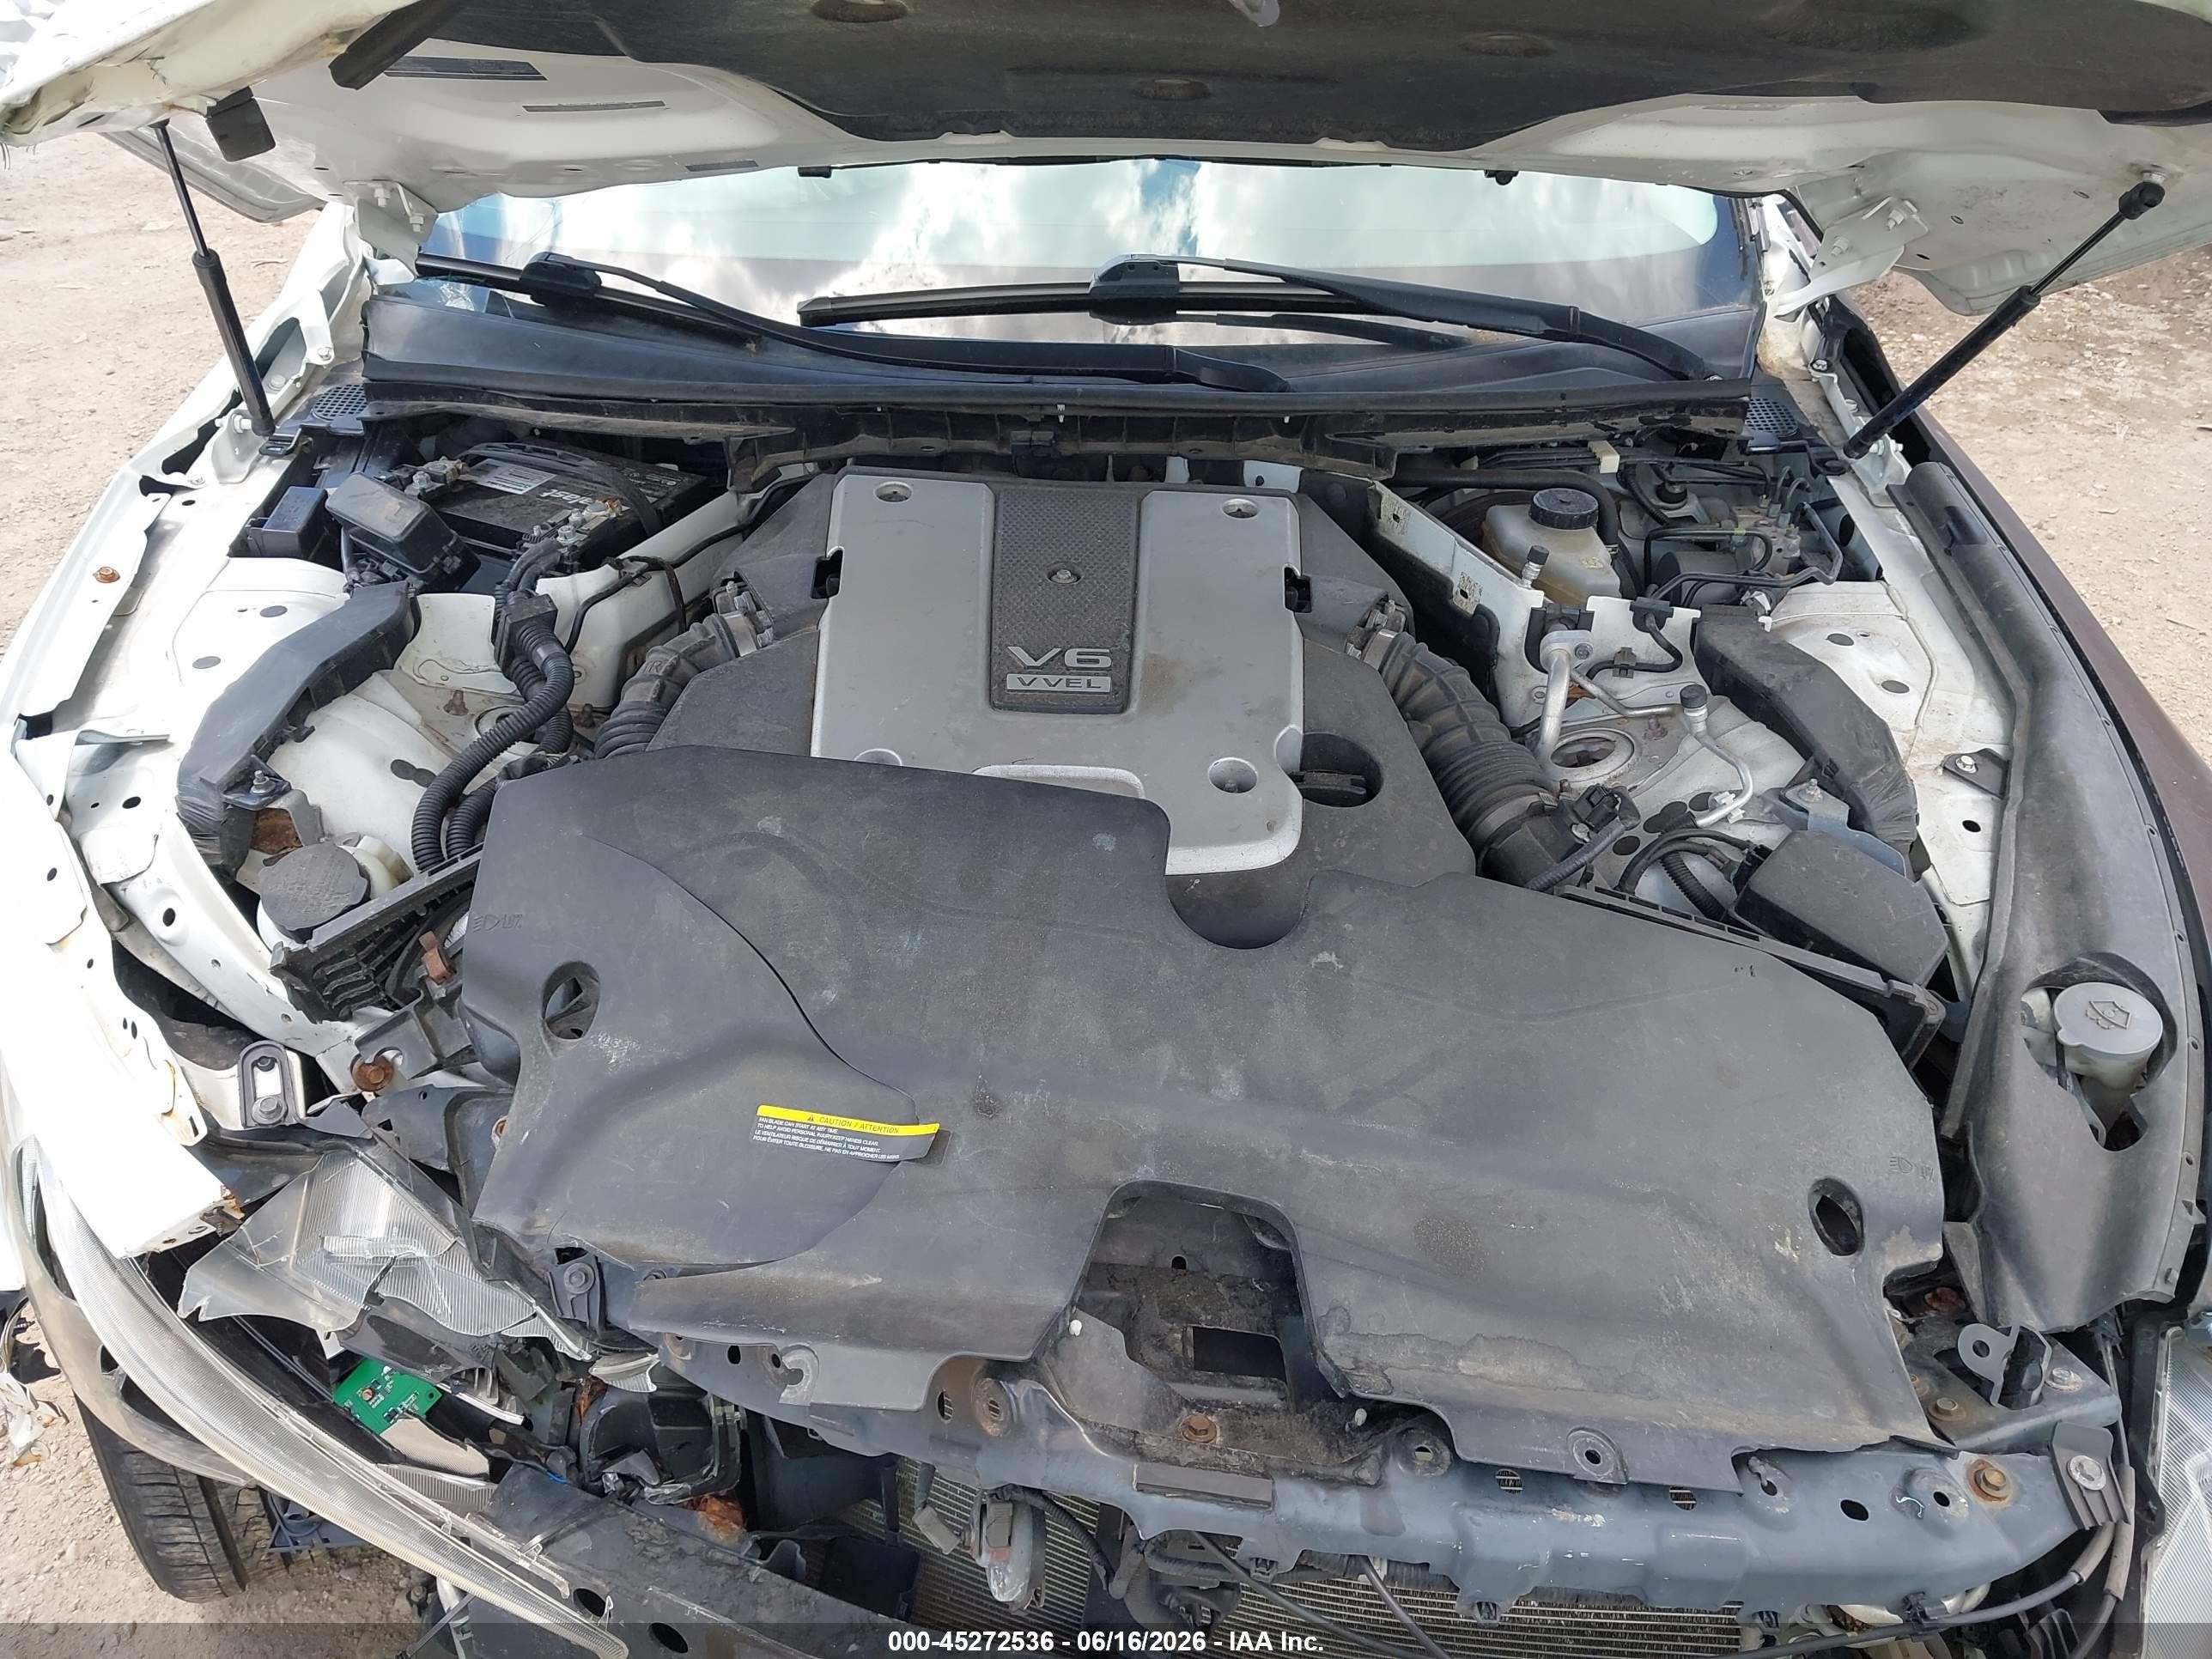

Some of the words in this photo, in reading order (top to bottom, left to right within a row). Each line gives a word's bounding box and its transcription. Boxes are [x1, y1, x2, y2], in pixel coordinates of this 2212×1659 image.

[1007, 646, 1112, 668] V6
[1017, 676, 1102, 689] VVEL
[819, 1116, 853, 1127] CAUTION
[860, 1123, 900, 1133] ATTENTION
[762, 1130, 791, 1139] VENTILATEUR
[791, 1127, 816, 1136] PERSONAL
[849, 1150, 878, 1158] APPROCHER
